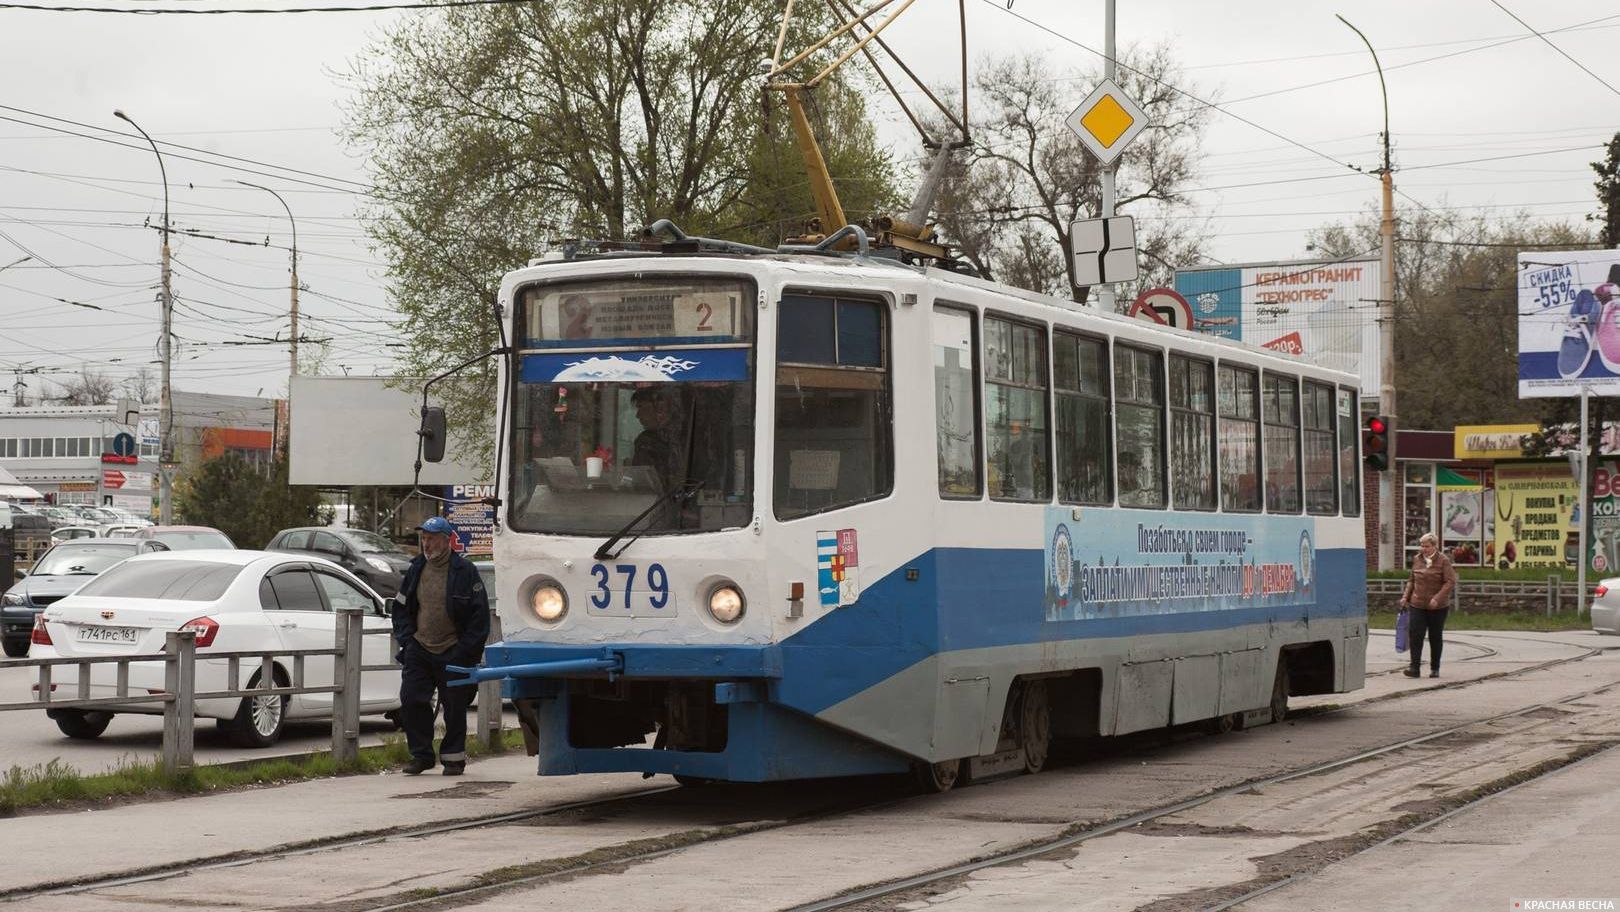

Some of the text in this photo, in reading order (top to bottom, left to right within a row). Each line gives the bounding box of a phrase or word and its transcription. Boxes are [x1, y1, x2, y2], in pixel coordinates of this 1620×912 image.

[1256, 267, 1363, 288] КЕРАМОГРАНИТ
[1530, 266, 1573, 288] СКИДКА
[1534, 280, 1577, 308] -55%
[696, 303, 713, 332] 2
[1137, 522, 1186, 553] Позаботься
[1187, 529, 1194, 553] о
[1195, 529, 1219, 553] своем
[1220, 530, 1246, 556] городе
[1521, 529, 1560, 541] ПРЕДМЕТОВ
[1525, 545, 1557, 556] СТАРИНЫ
[590, 563, 669, 610] 379
[1081, 564, 1128, 602] ЗАПЛАТИ
[1129, 563, 1209, 602] ИМУЩЕСТВЕННЫЕ
[1210, 563, 1241, 597] НАЛОГИ
[1242, 563, 1254, 599] ДО
[1261, 562, 1295, 598] ДЕКАБРЯ
[120, 629, 136, 639] 161
